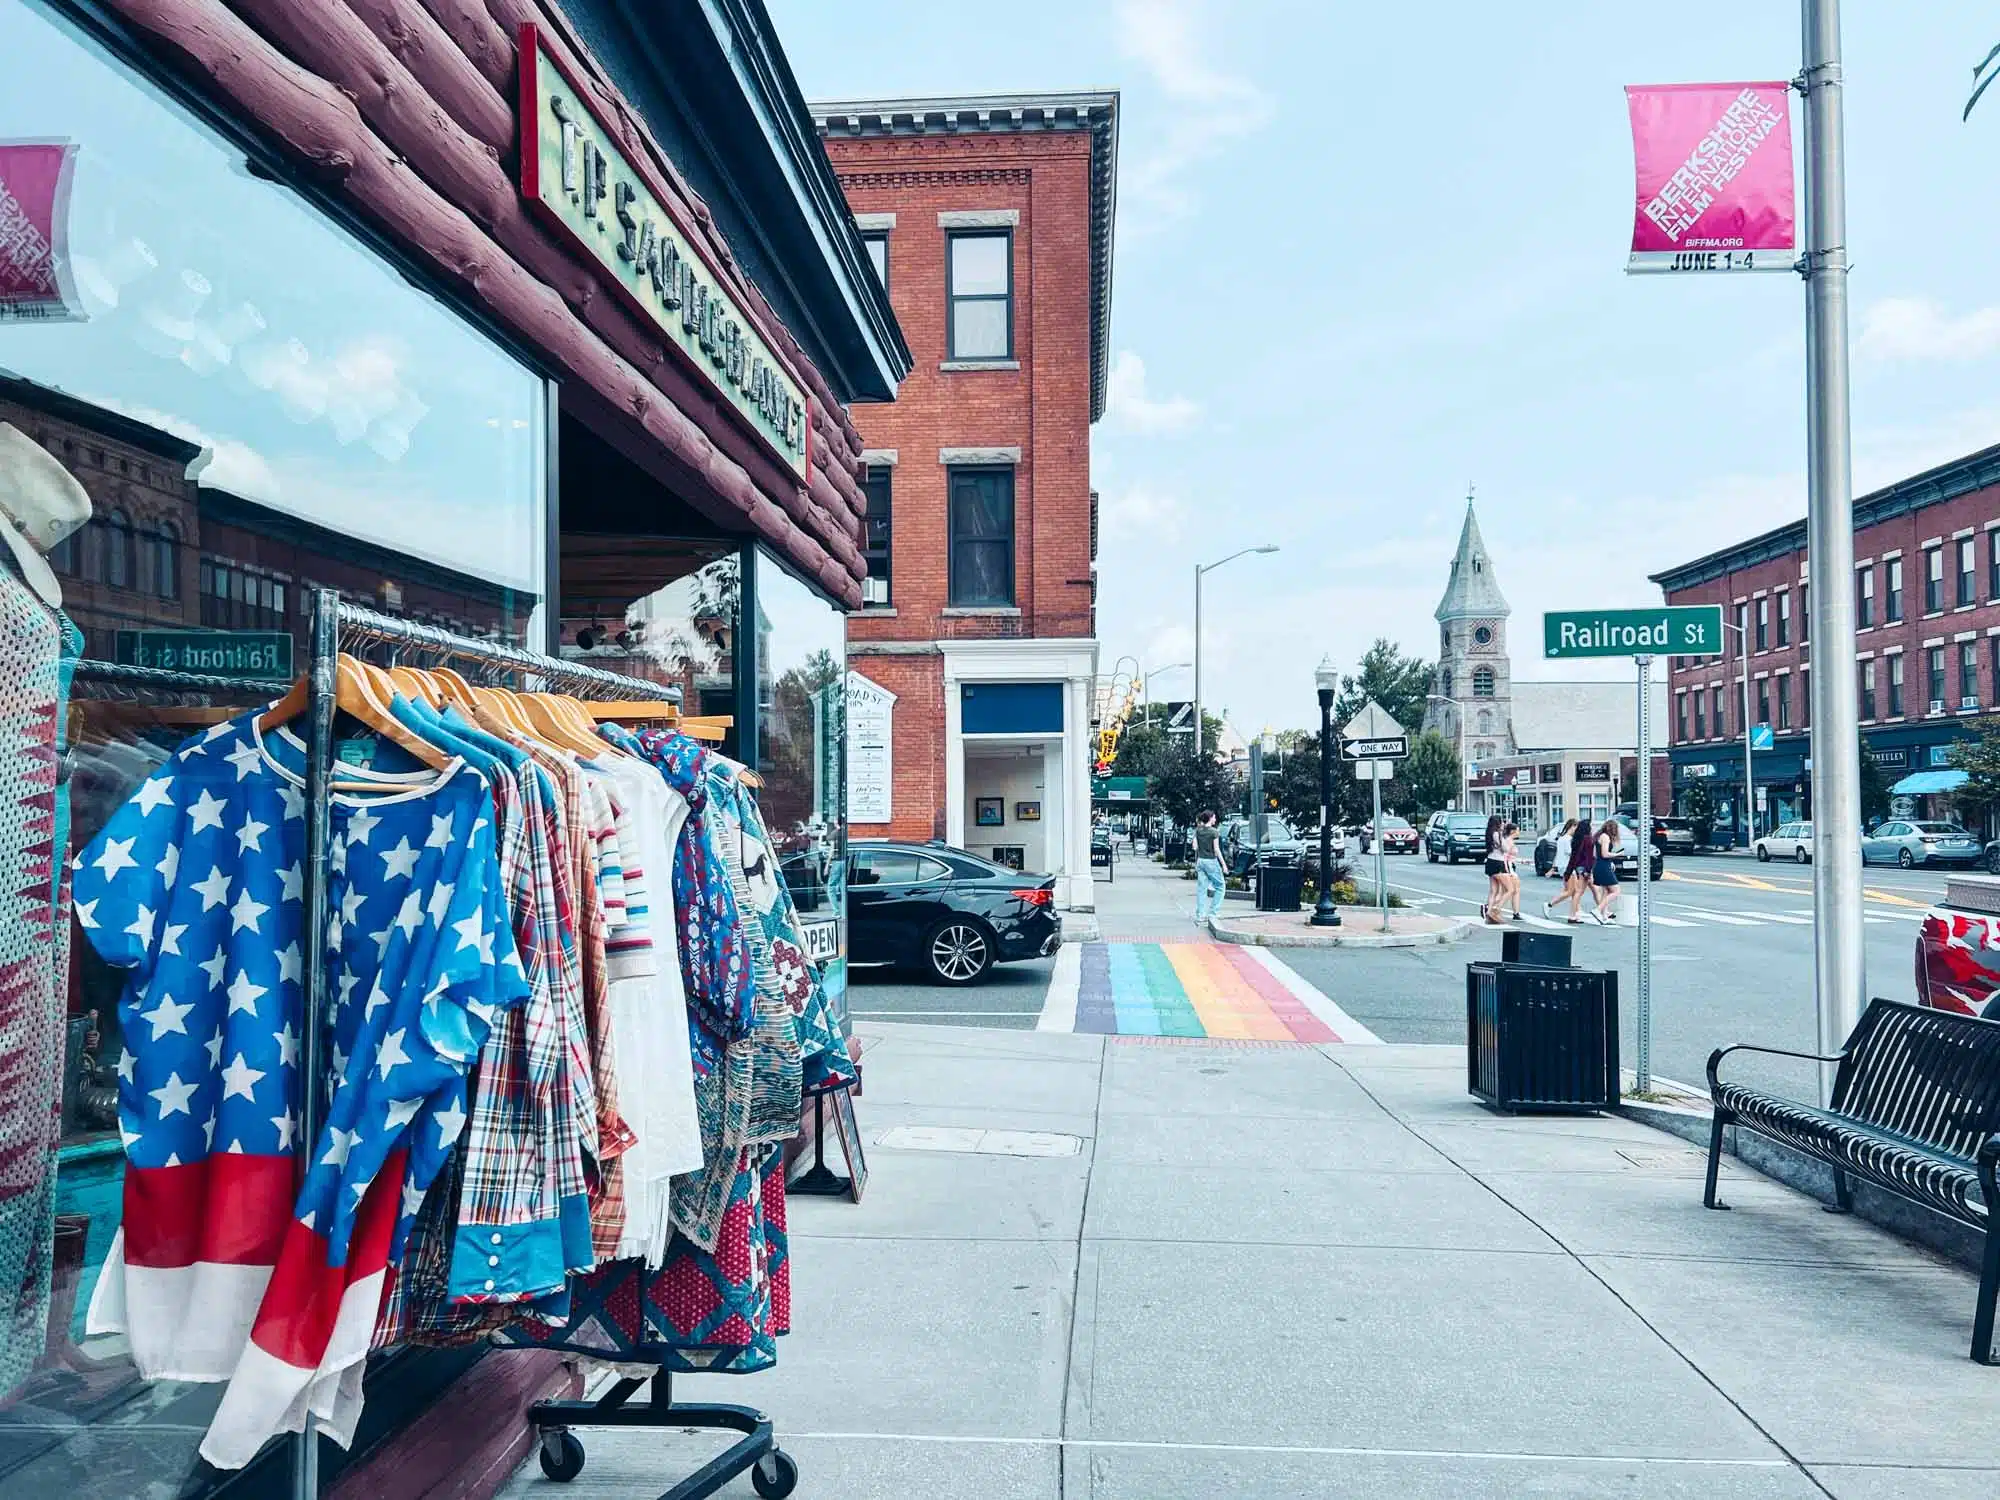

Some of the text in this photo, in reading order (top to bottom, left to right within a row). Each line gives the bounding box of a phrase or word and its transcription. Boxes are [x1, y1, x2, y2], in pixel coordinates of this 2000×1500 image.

[1643, 87, 1760, 223] BERKSHIRE
[1656, 102, 1772, 233] INTERNATIONAL
[1666, 111, 1784, 243] FILM FESTIVAL
[1685, 237, 1744, 248] BIFFMA.ORG
[1670, 251, 1754, 271] JUNE 1-4
[1560, 618, 1705, 649] Railroad St
[1360, 742, 1400, 753] ONE WAY
